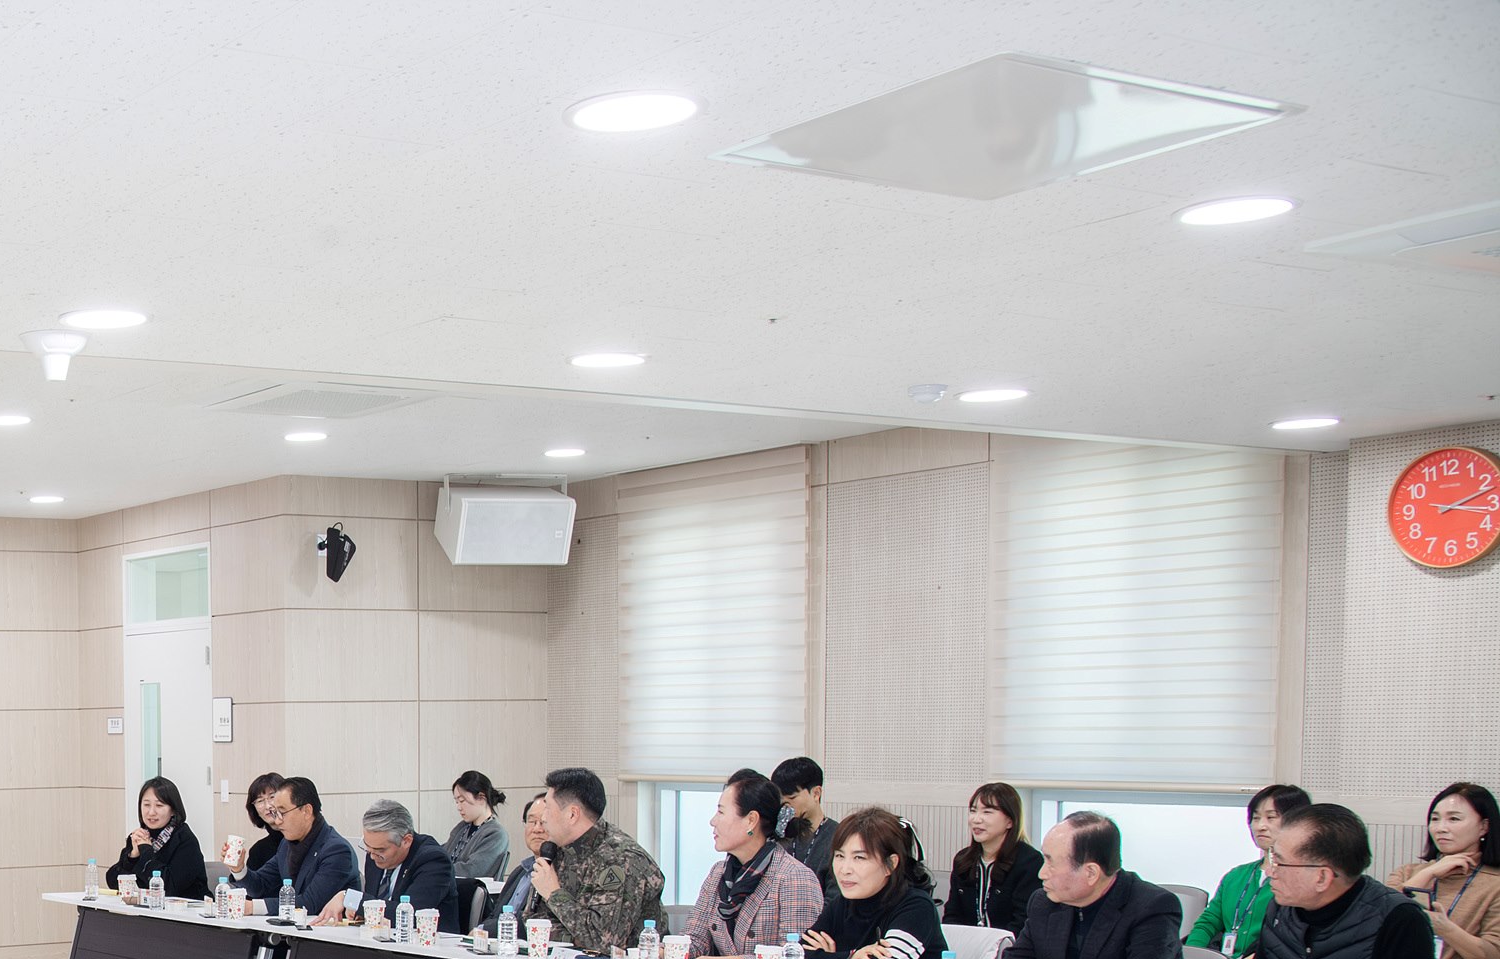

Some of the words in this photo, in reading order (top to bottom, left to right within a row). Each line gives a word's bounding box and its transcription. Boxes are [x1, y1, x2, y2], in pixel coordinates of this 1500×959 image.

[1421, 465, 1437, 482] 11
[1440, 459, 1459, 476] 12
[1466, 462, 1475, 478] 1
[1407, 483, 1426, 499] 10
[1479, 474, 1492, 491] 2
[1486, 494, 1499, 511] 3
[1403, 504, 1415, 521] 9
[1409, 523, 1422, 539] 8
[1479, 514, 1492, 531] 4
[1425, 537, 1438, 554] 7
[1444, 539, 1457, 556] 6
[1466, 532, 1478, 549] 5
